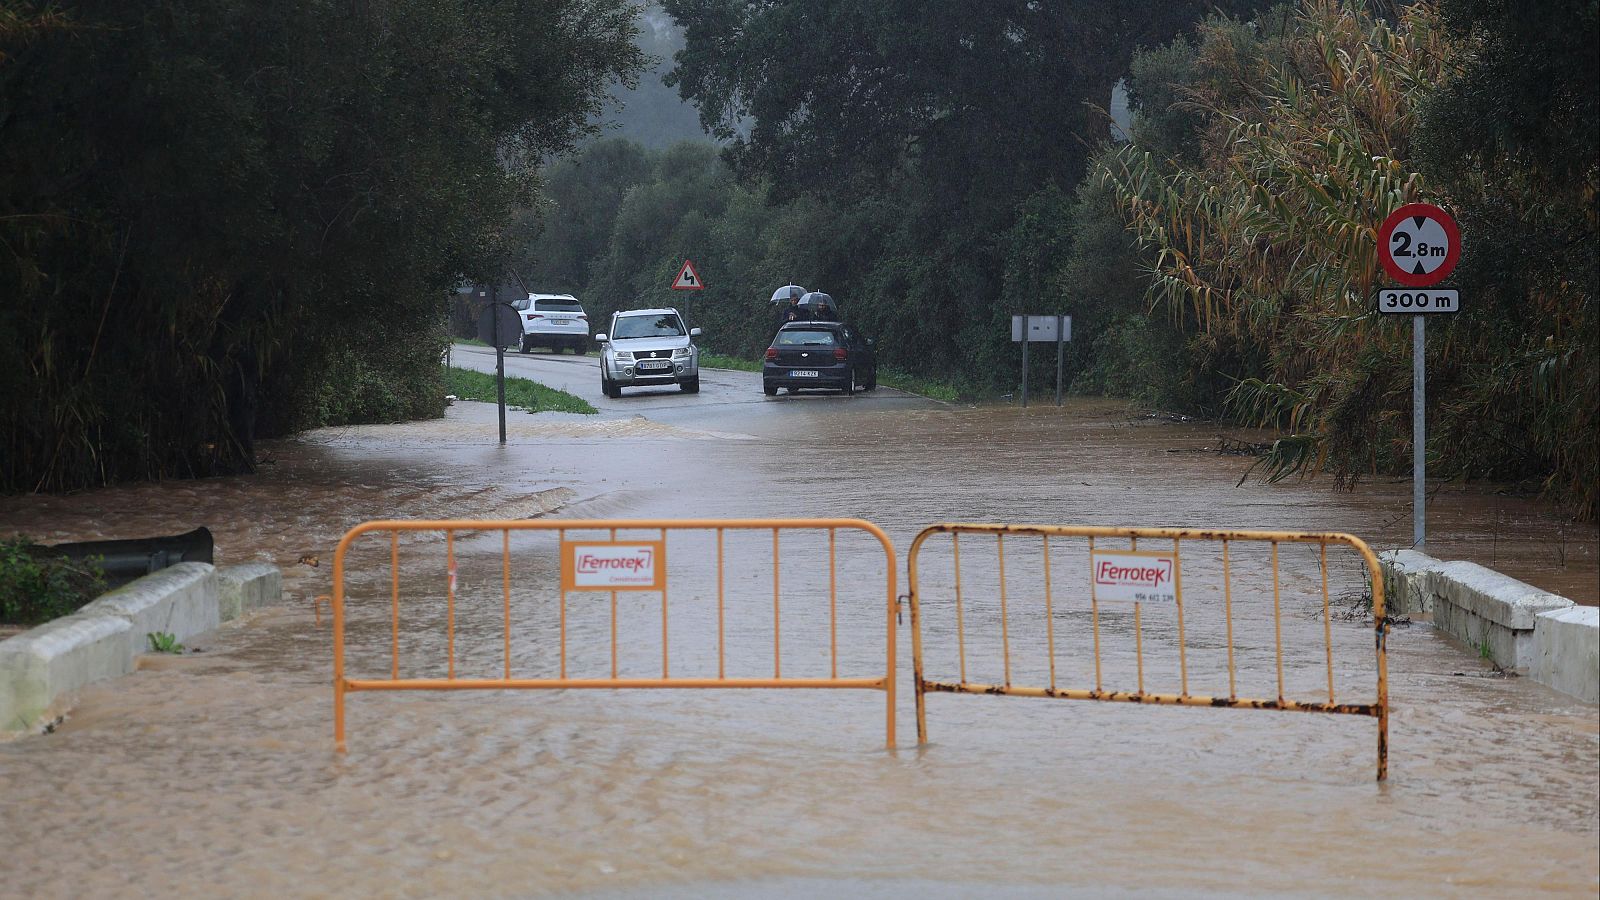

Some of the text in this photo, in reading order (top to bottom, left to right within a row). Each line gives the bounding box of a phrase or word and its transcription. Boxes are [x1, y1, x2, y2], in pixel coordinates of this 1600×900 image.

[1386, 293, 1451, 308] 300 m
[582, 555, 645, 574] Ferrotek
[1100, 561, 1166, 588] Ferrotek
